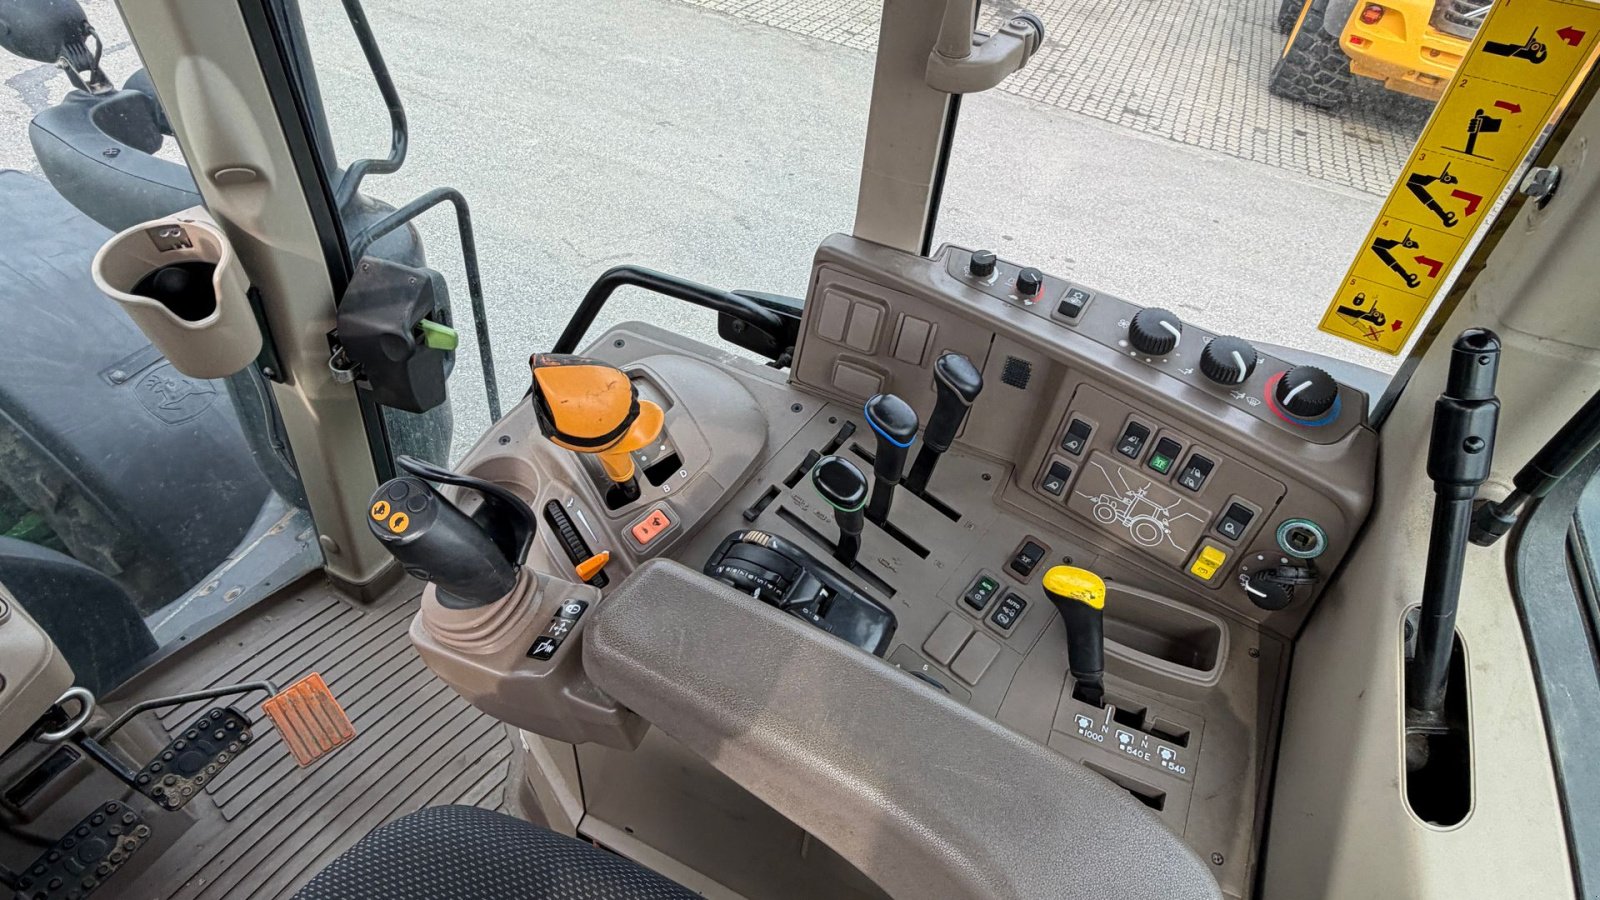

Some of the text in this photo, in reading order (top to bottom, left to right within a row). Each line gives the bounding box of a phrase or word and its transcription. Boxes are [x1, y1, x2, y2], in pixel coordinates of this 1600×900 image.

[1459, 79, 1467, 88] 2
[1418, 152, 1426, 161] 3
[1382, 219, 1389, 228] 4
[1350, 278, 1356, 286] 5
[1006, 599, 1020, 609] AUTO
[1084, 730, 1103, 742] 1000
[1168, 763, 1186, 774] 540
